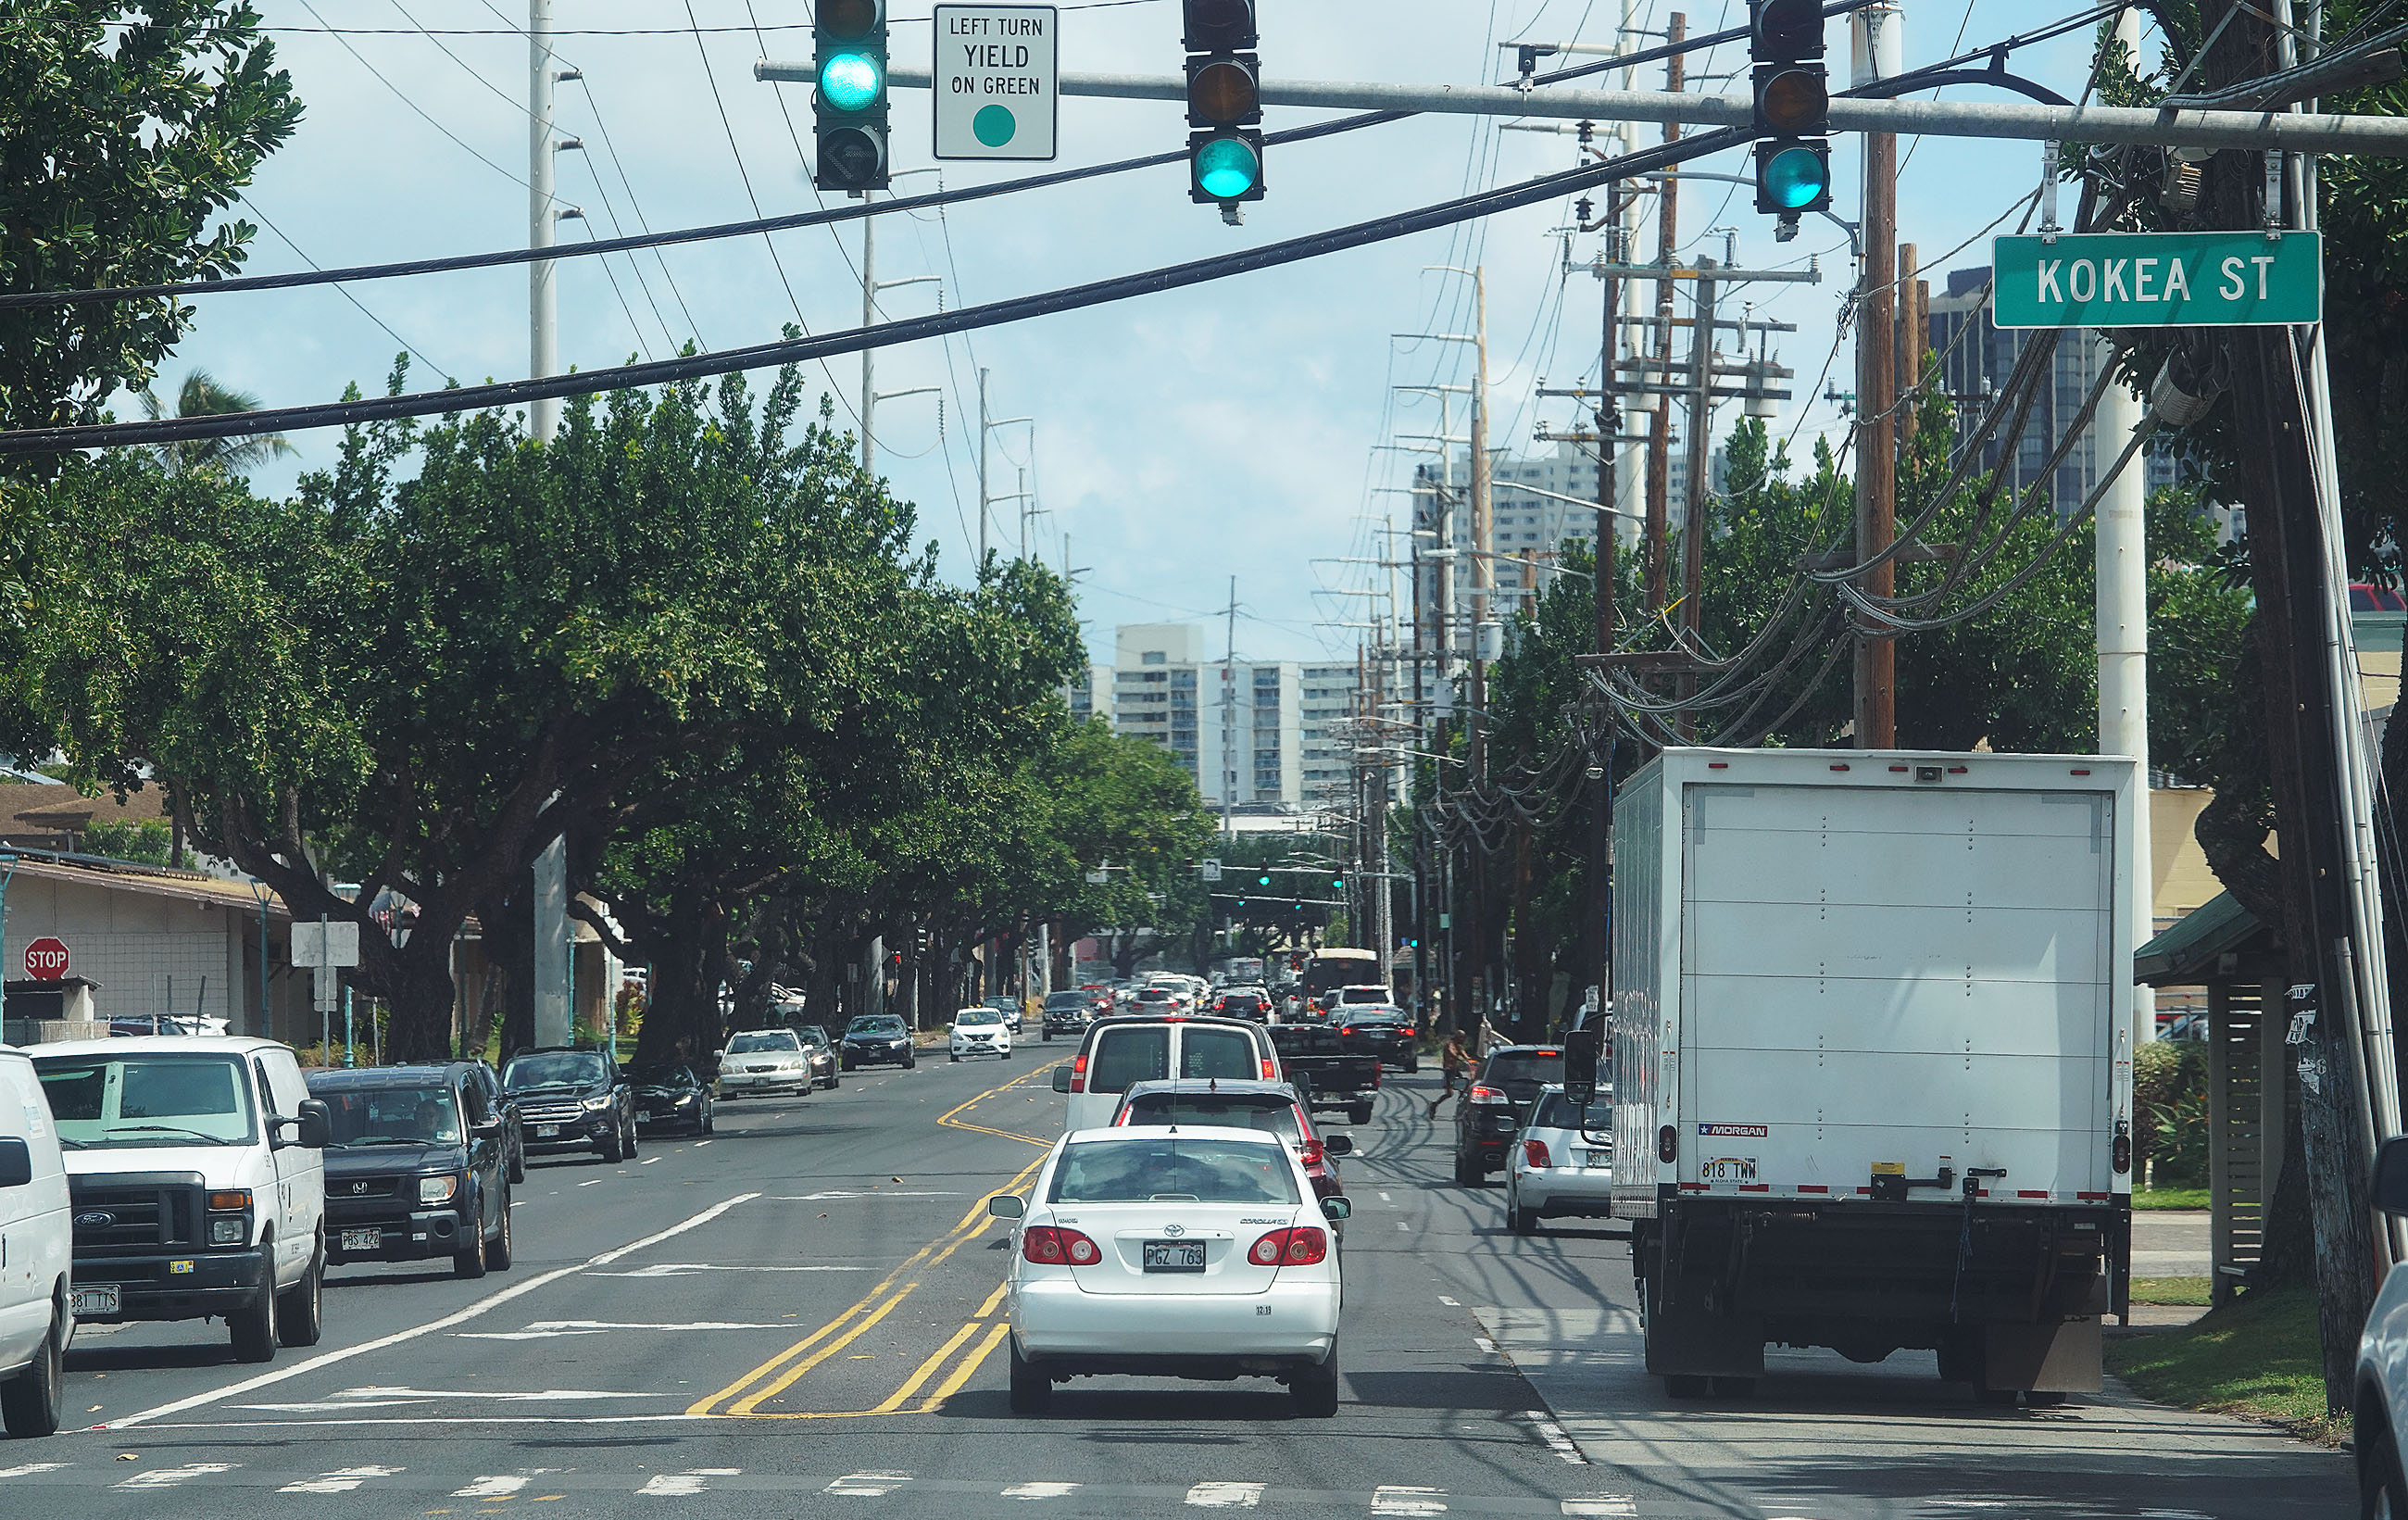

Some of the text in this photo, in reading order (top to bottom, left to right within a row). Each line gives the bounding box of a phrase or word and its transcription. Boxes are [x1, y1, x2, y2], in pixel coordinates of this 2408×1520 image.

[950, 18, 1043, 36] LEFT TURN
[963, 44, 1029, 68] YIELD
[951, 76, 1039, 94] ON GREEN
[2038, 256, 2275, 303] KOKEA ST
[27, 950, 67, 969] STOP
[1712, 1125, 1765, 1136] MORGAN
[1702, 1162, 1756, 1179] 818 TWW
[343, 1233, 379, 1246] PBS 422
[1147, 1249, 1202, 1265] PGZ 763
[96, 1292, 117, 1306] TTS
